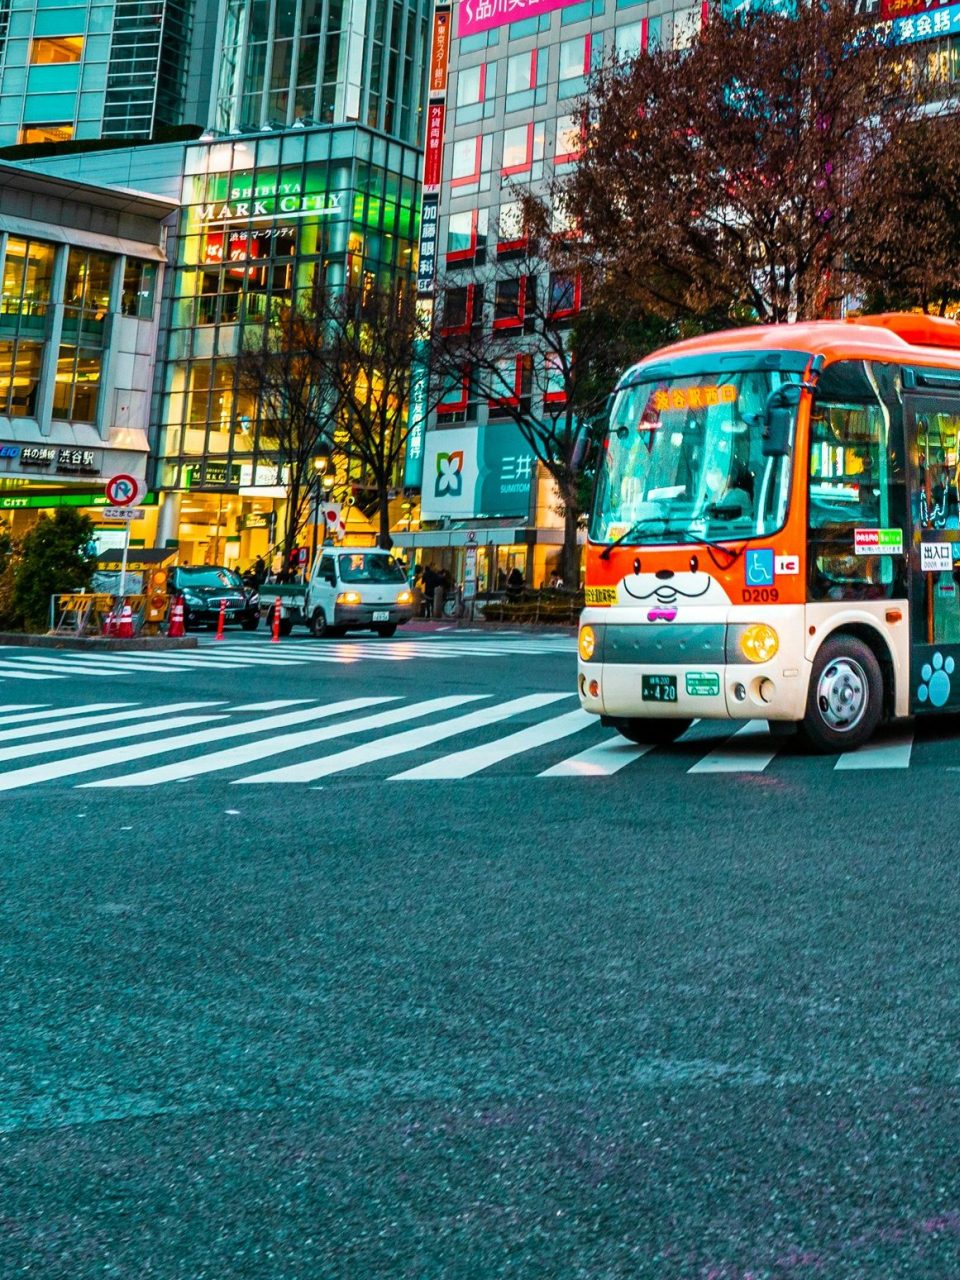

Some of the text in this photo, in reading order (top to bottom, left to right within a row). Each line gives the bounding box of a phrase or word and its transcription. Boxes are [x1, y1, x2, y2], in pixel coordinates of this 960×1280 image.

[434, 25, 446, 88] 東京スター銀行
[429, 107, 441, 149] 外貨両替
[231, 183, 302, 200] SHIBUYA
[194, 193, 343, 220] MARK CITY
[229, 227, 295, 242] 渋谷 マークシティ
[420, 205, 437, 276] 加藤眼科
[654, 384, 737, 411] 渋谷駅西口
[0, 446, 19, 458] EIO
[22, 448, 55, 460] 井の頭線
[59, 450, 94, 465] 渋谷駅
[3, 499, 28, 507] CITY
[105, 509, 134, 518] ここまで
[924, 546, 950, 559] 出入口
[742, 589, 780, 602] D209
